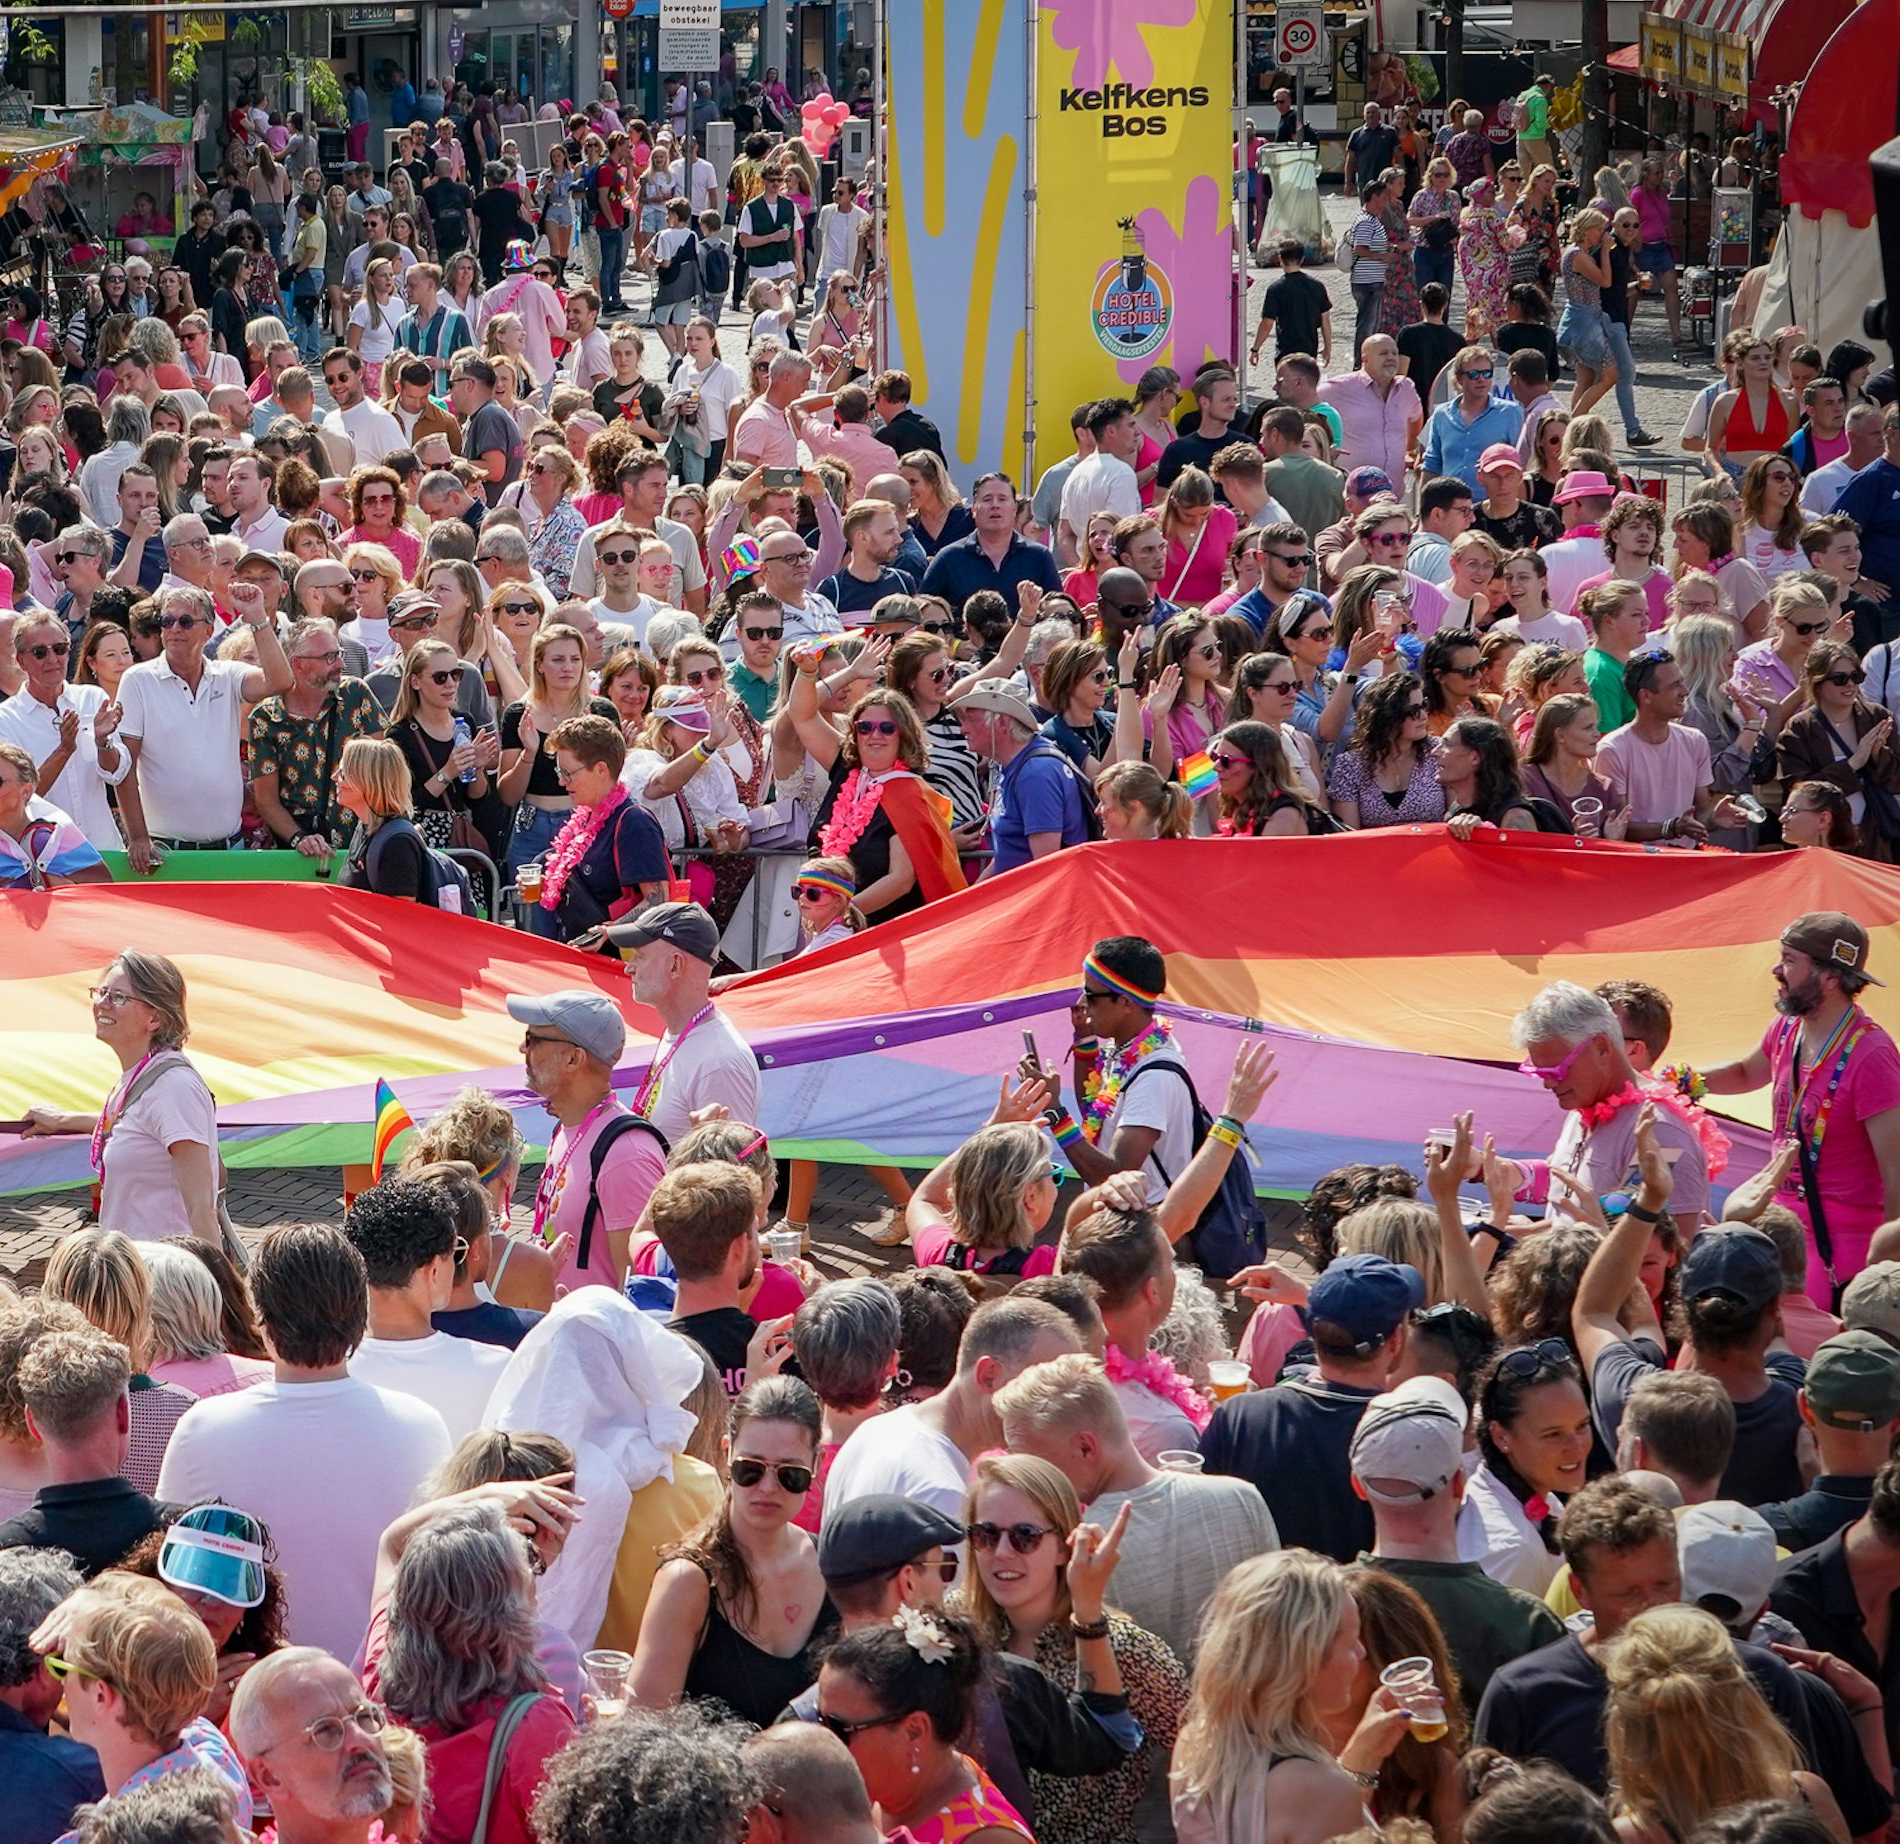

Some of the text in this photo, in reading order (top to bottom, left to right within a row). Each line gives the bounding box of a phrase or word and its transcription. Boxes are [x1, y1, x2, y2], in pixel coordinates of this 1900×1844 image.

[663, 4, 718, 14] beweegbaar
[670, 16, 710, 24] obstakel
[1290, 30, 1310, 42] 30
[1059, 83, 1209, 112] Kelfkens
[1102, 114, 1167, 138] Bos
[1108, 292, 1157, 309] HOTEL
[1098, 308, 1168, 327] CREDIBLE
[1099, 326, 1166, 357] VIERDAAGSEFEESTEN
